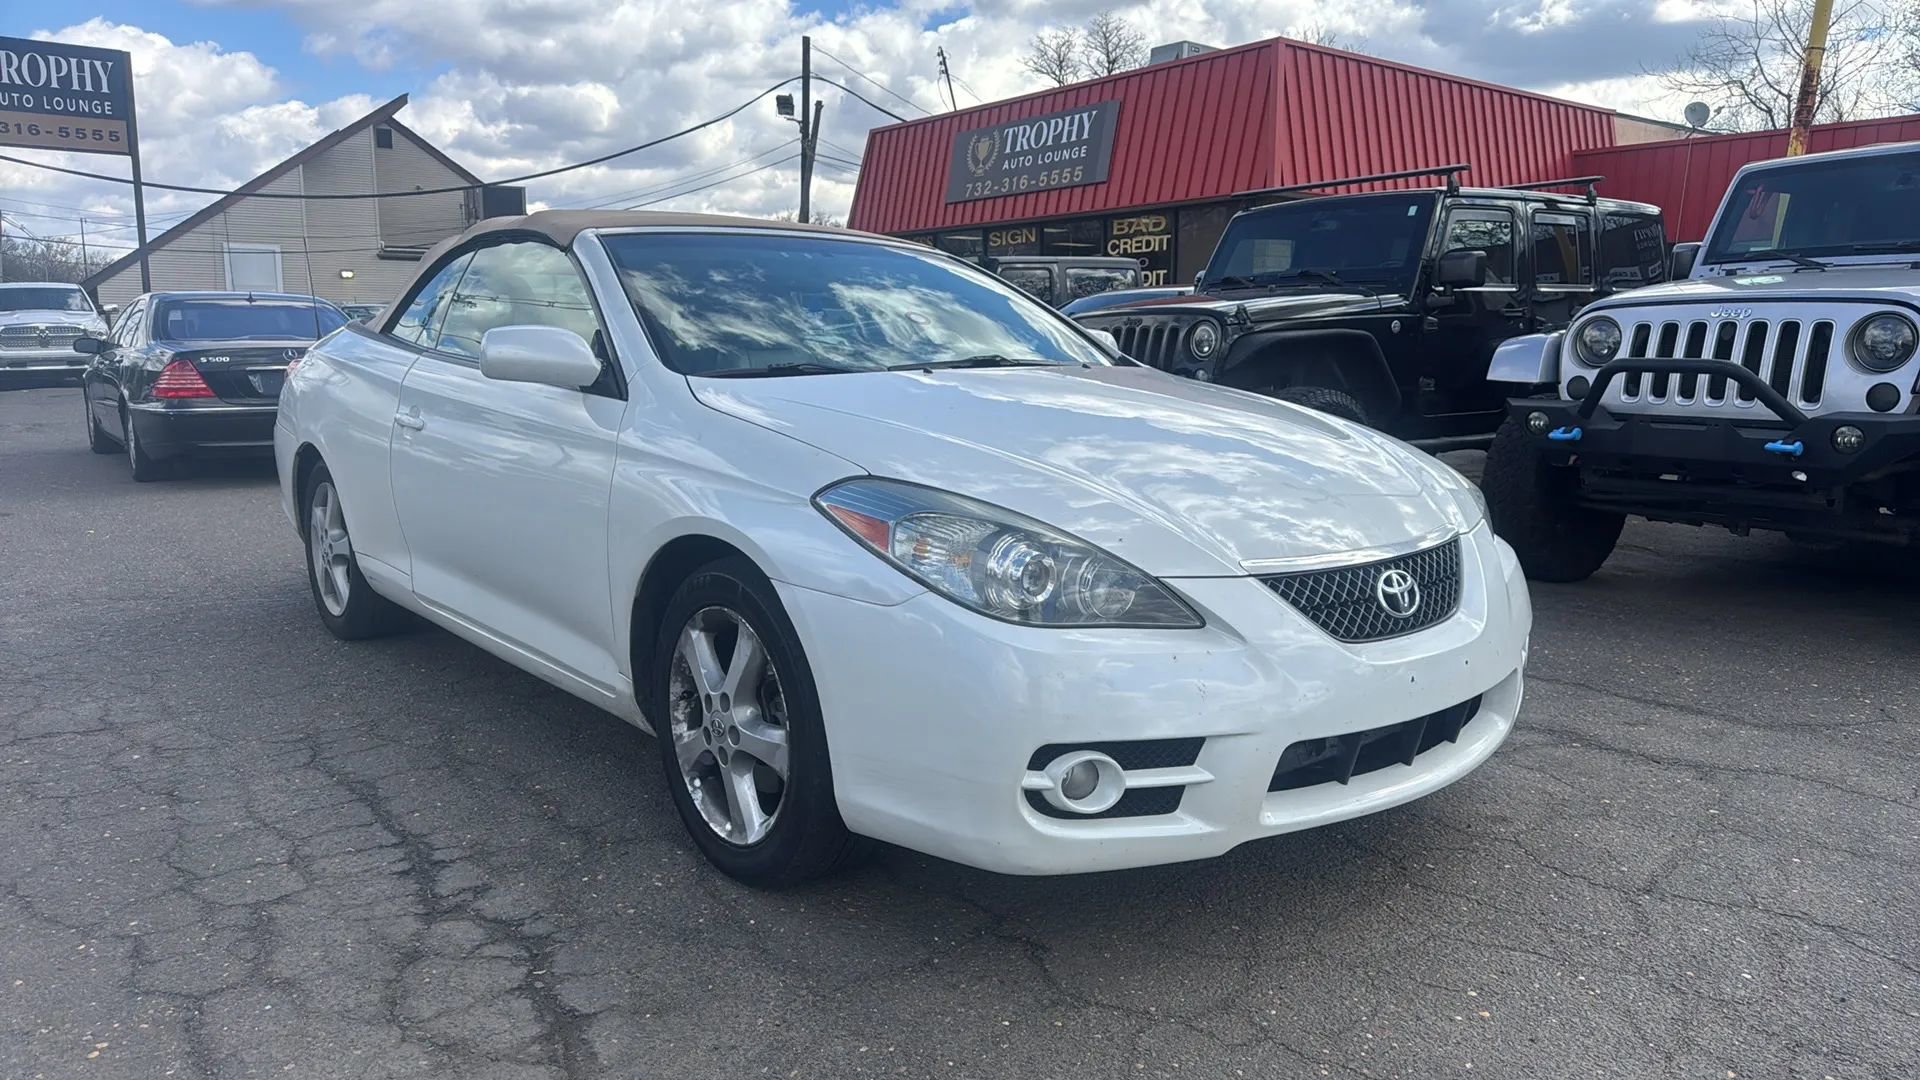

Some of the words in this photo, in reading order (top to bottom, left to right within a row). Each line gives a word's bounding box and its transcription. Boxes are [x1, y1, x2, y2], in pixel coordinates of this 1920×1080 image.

[0, 49, 114, 94] ROPHY
[0, 91, 34, 108] UTO
[43, 95, 113, 115] LOUNGE
[0, 120, 121, 142] 316-5555
[1003, 110, 1098, 154] TROPHY
[1002, 154, 1033, 171] AUTO
[1037, 145, 1088, 165] LOUNGE
[965, 165, 1084, 198] 732-316-5555
[1112, 215, 1167, 235] BAD
[989, 227, 1036, 247] SIGN
[1107, 234, 1172, 256] CREDIT
[1141, 269, 1168, 287] DIT
[1710, 304, 1752, 319] Jeep
